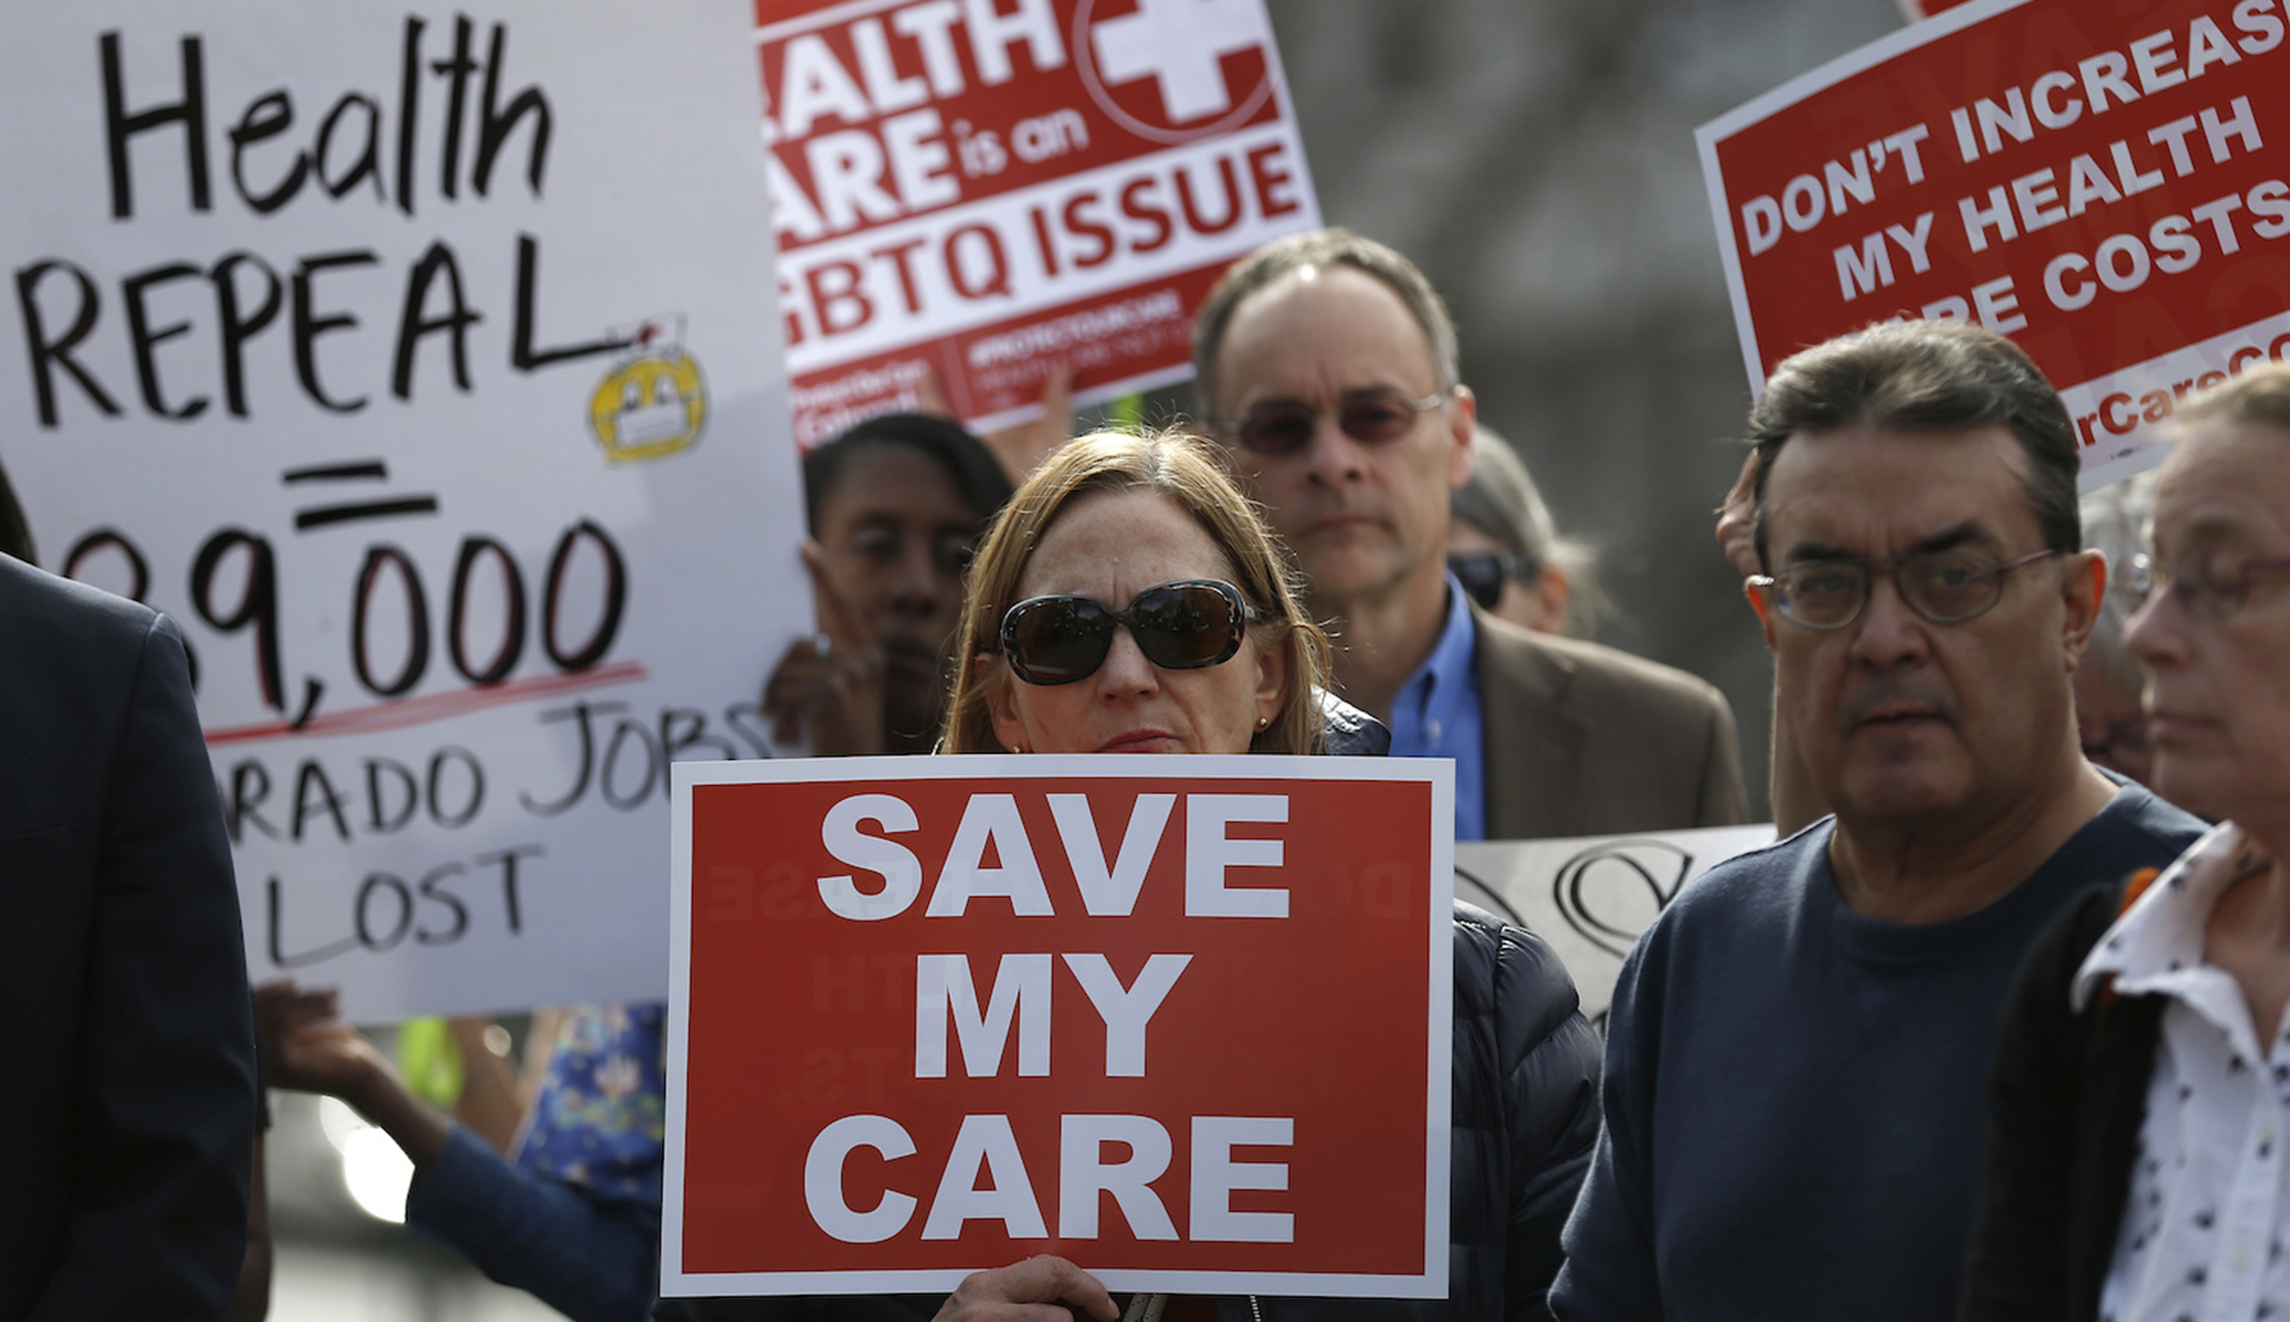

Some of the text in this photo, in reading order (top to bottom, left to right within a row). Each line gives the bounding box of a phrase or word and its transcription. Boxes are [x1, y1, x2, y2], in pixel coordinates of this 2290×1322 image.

[97, 11, 552, 222] Health
[762, 0, 1066, 143] ALTH
[1741, 0, 2290, 257] DON'T INCREAS
[952, 118, 1007, 179] is
[1012, 108, 1090, 164] an
[1028, 141, 1303, 278] ISSUE
[1832, 95, 2264, 302] MY HEALTH
[14, 231, 638, 430] REPEAL
[219, 744, 485, 844] RADO
[817, 792, 1290, 921] SAVE
[266, 843, 546, 968] LOST
[914, 953, 1195, 1078] MY
[804, 1114, 1295, 1244] CARE
